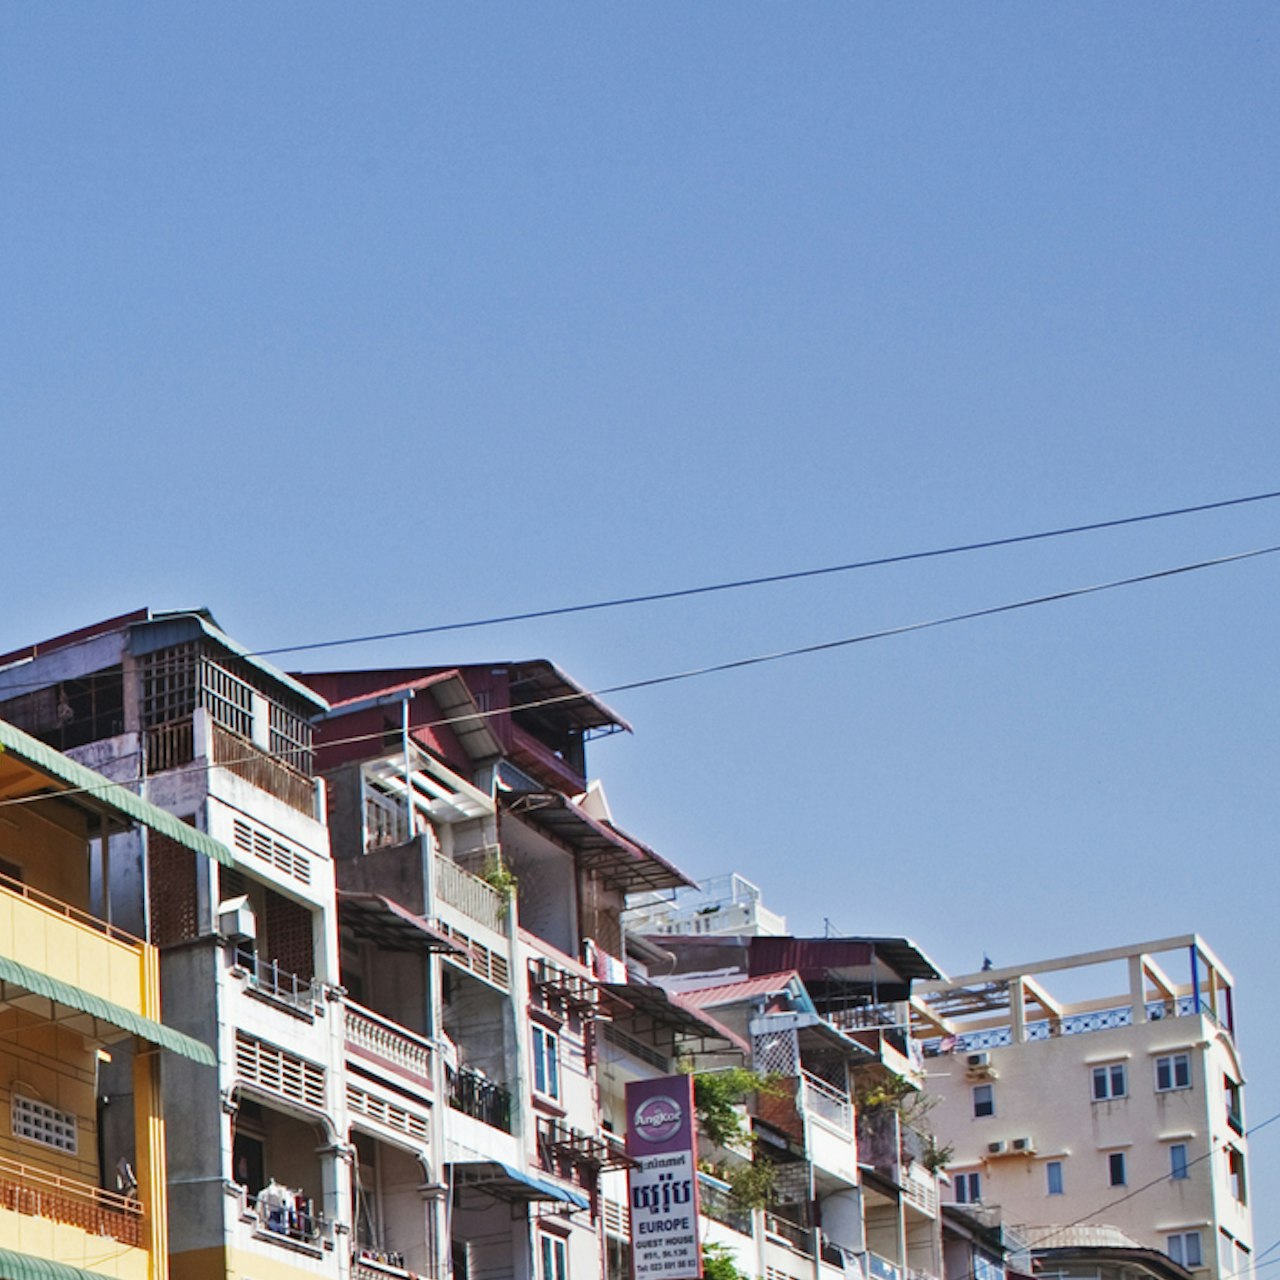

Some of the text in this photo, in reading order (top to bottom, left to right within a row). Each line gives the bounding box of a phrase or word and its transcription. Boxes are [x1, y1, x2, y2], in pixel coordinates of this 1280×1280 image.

[639, 1216, 690, 1235] EUROPE
[636, 1235, 694, 1249] GUEST HOUSE
